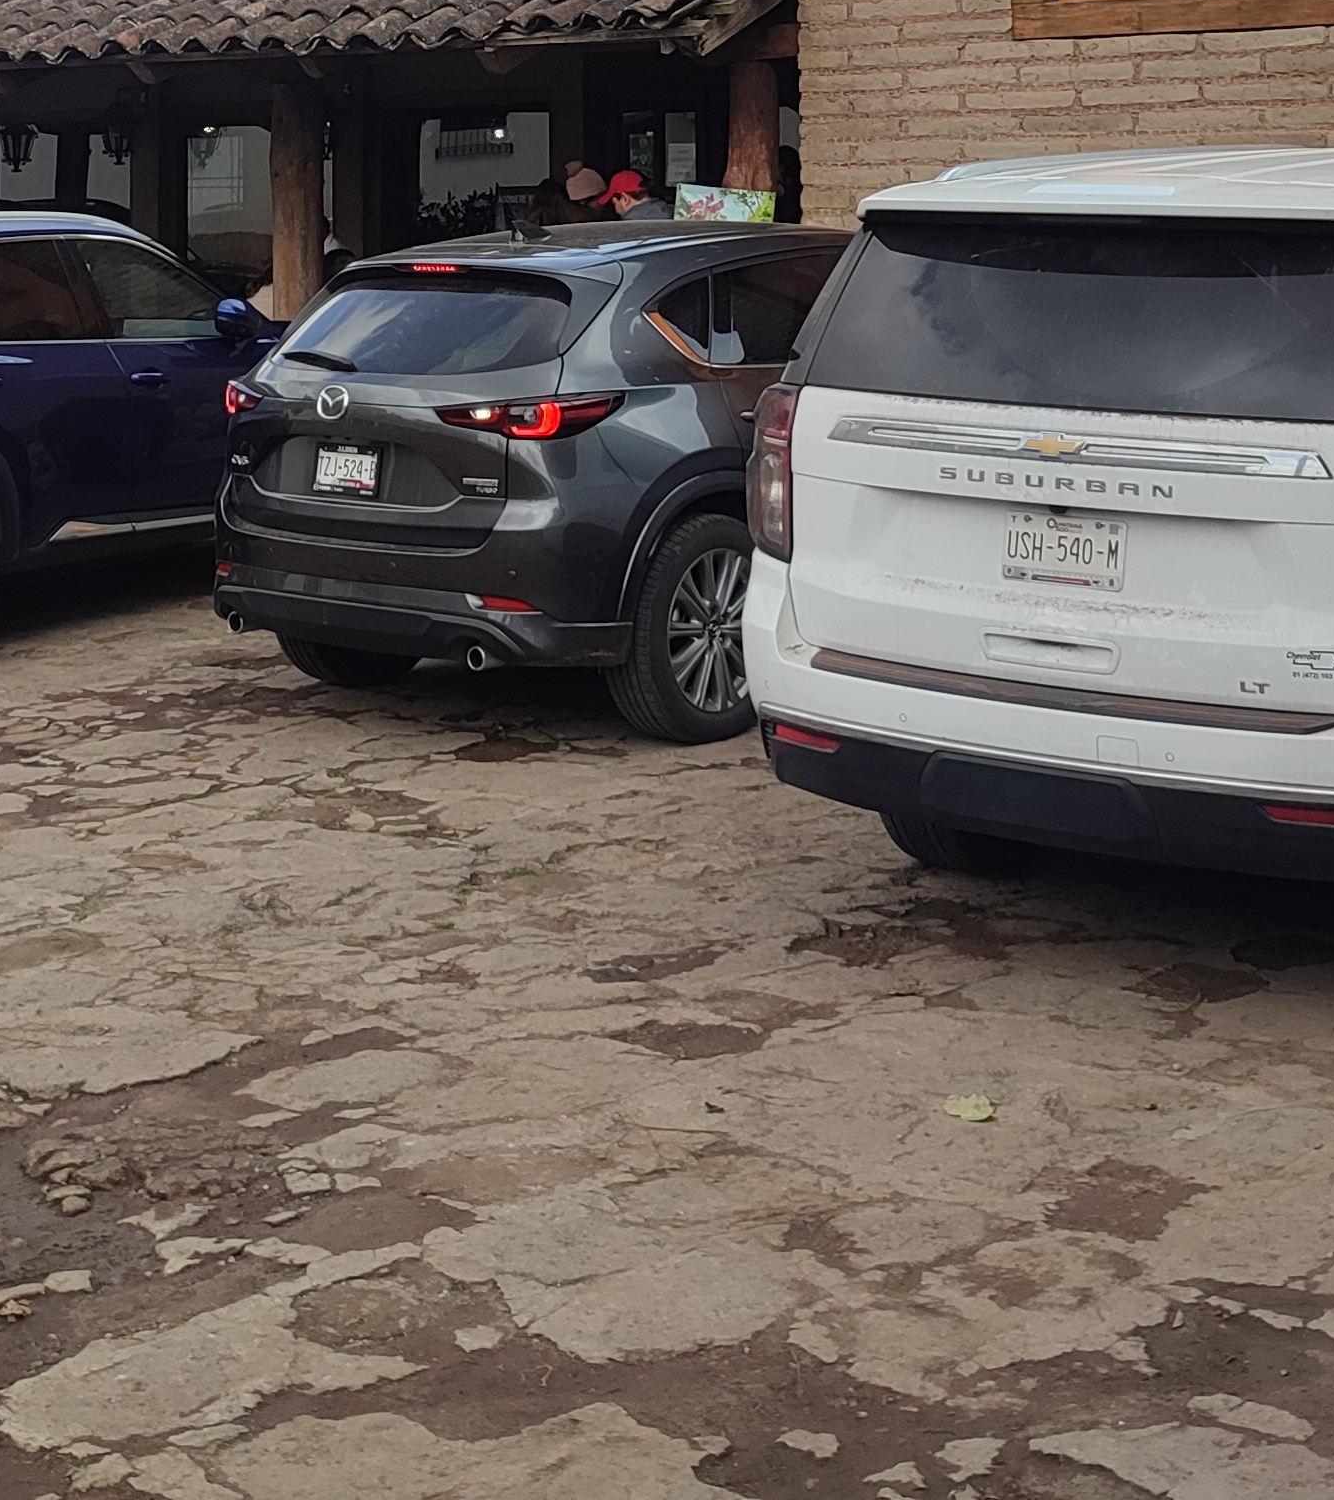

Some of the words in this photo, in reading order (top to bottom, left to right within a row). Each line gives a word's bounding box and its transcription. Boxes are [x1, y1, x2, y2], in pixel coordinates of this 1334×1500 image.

[939, 466, 1174, 499] SUBURBAN
[1007, 529, 1119, 570] USH-540-M
[1286, 651, 1322, 661] Chevrolet
[1239, 680, 1272, 695] LT
